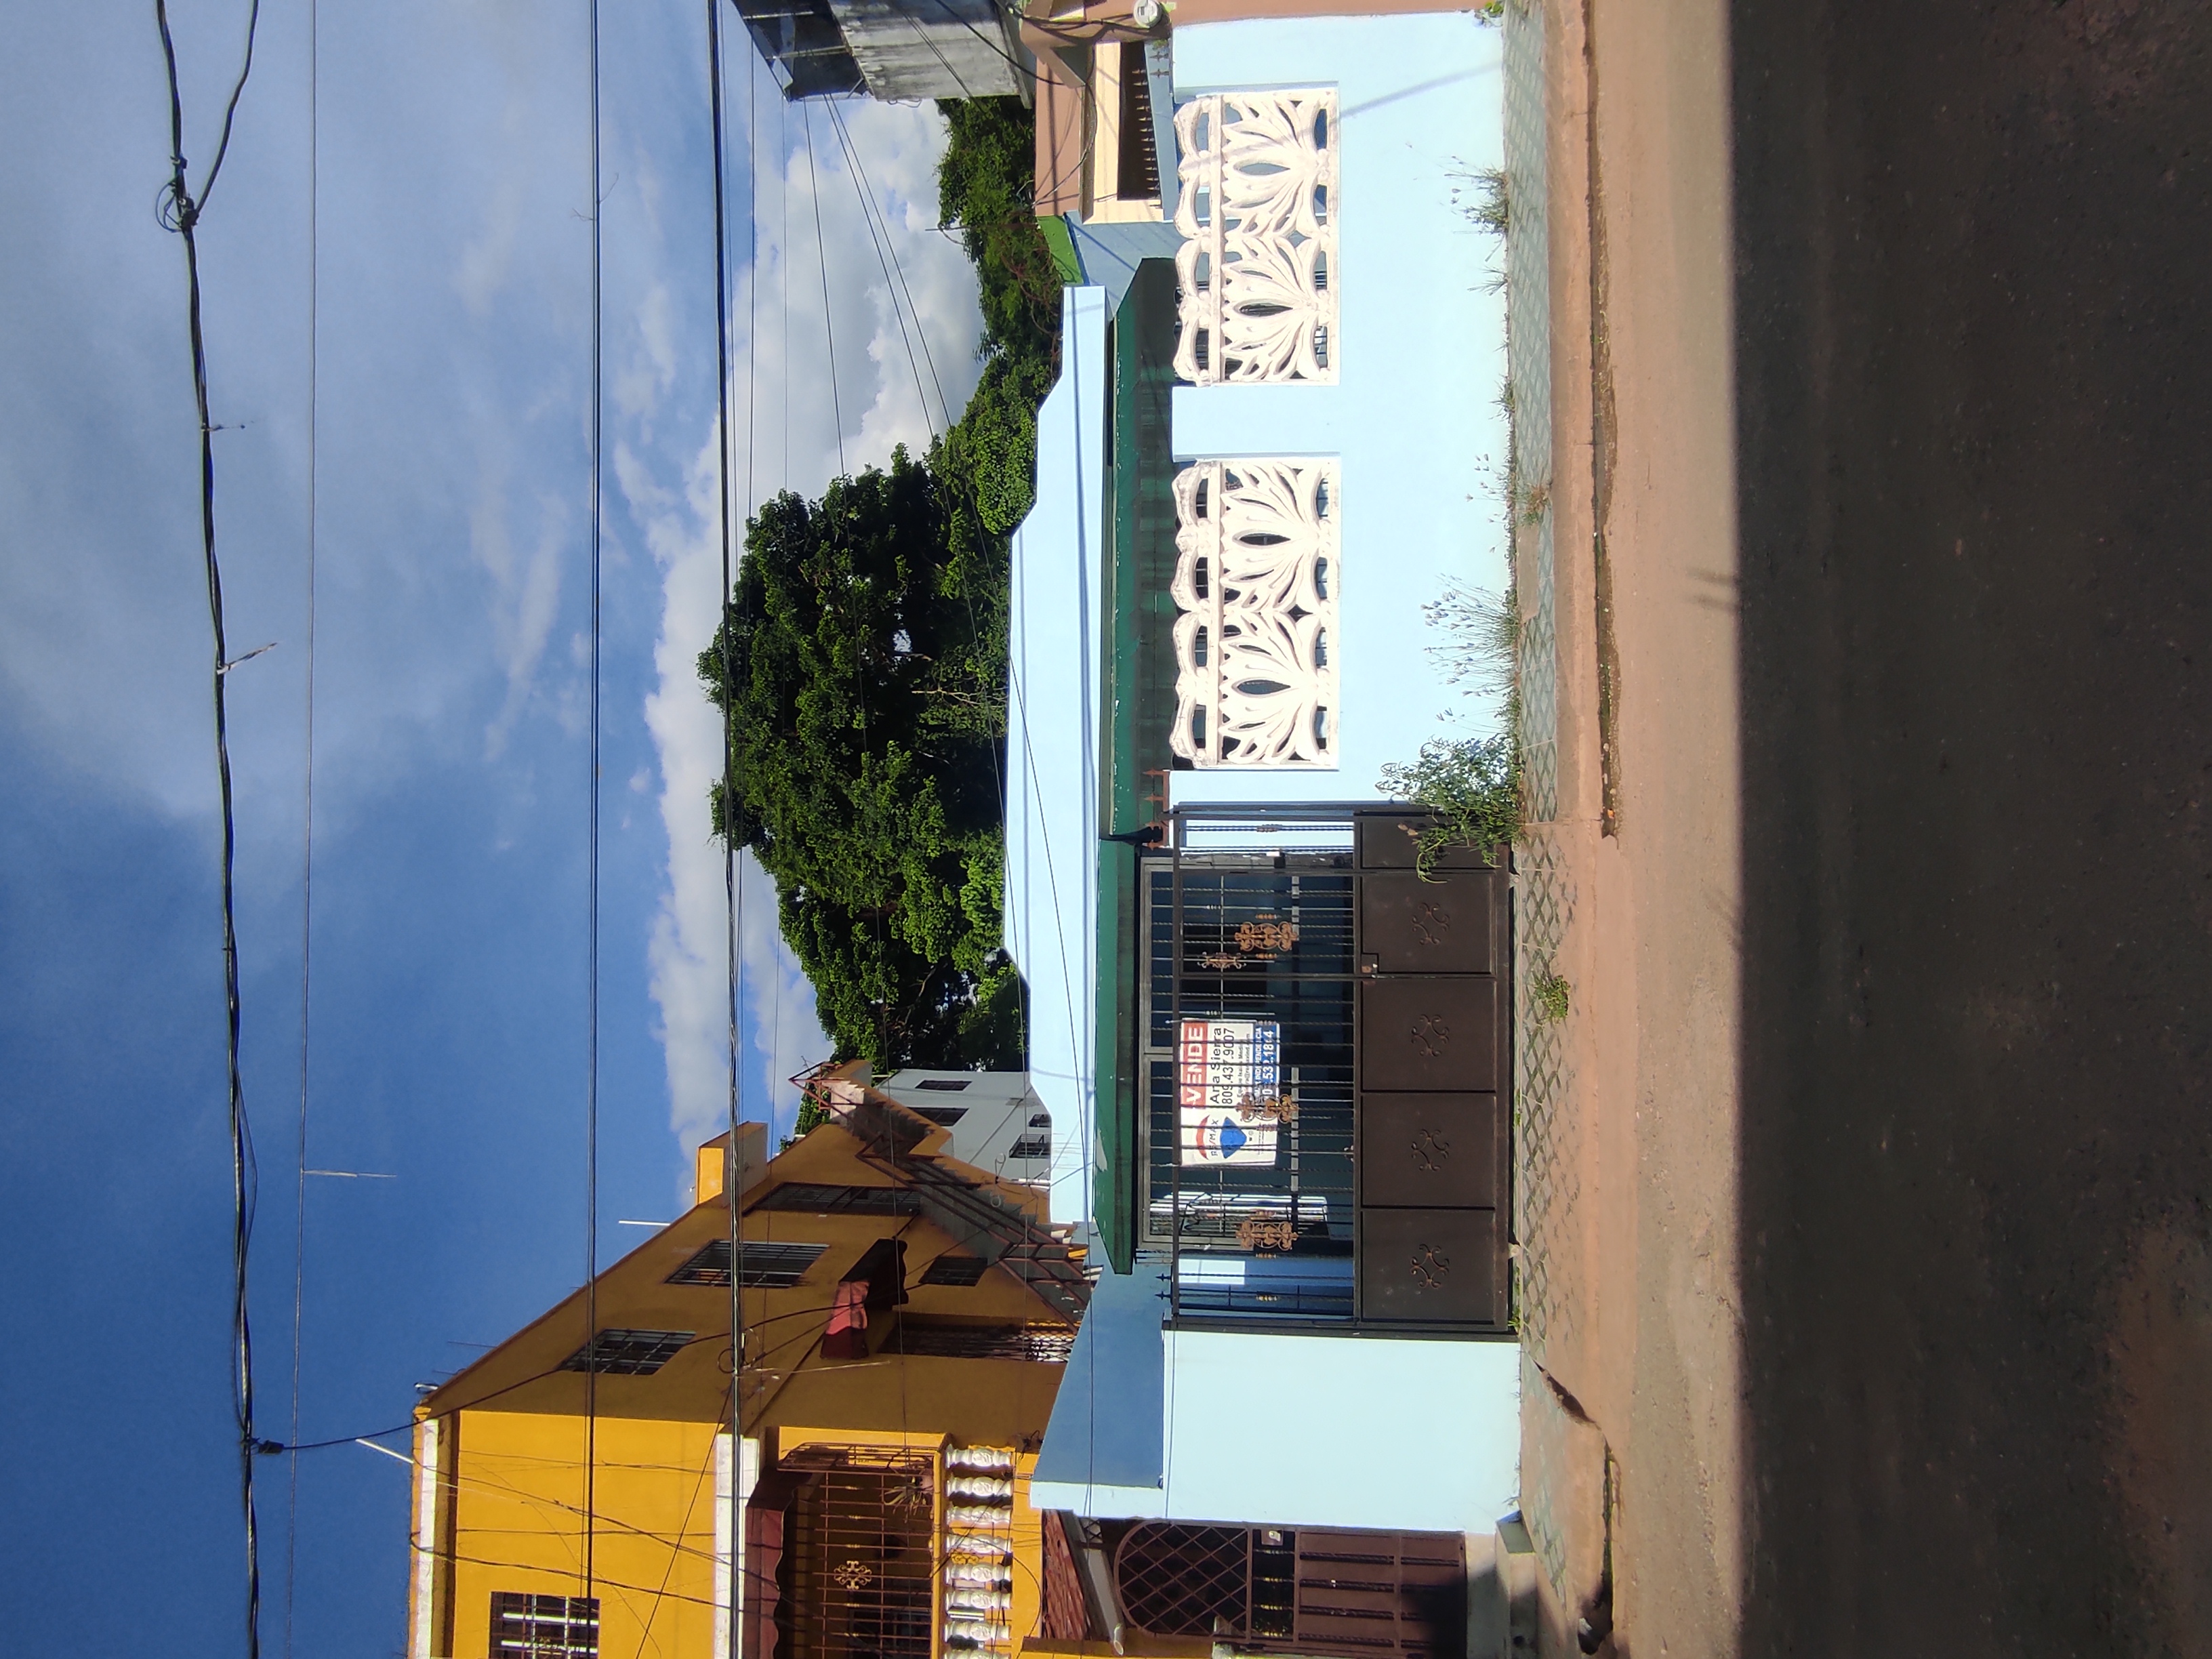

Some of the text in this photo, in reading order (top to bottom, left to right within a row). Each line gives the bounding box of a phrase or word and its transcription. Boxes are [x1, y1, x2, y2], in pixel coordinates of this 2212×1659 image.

[1186, 1027, 1203, 1102] VENDE
[1210, 1028, 1221, 1103] Ana Sierra
[1221, 1027, 1234, 1104] 809.437.9007
